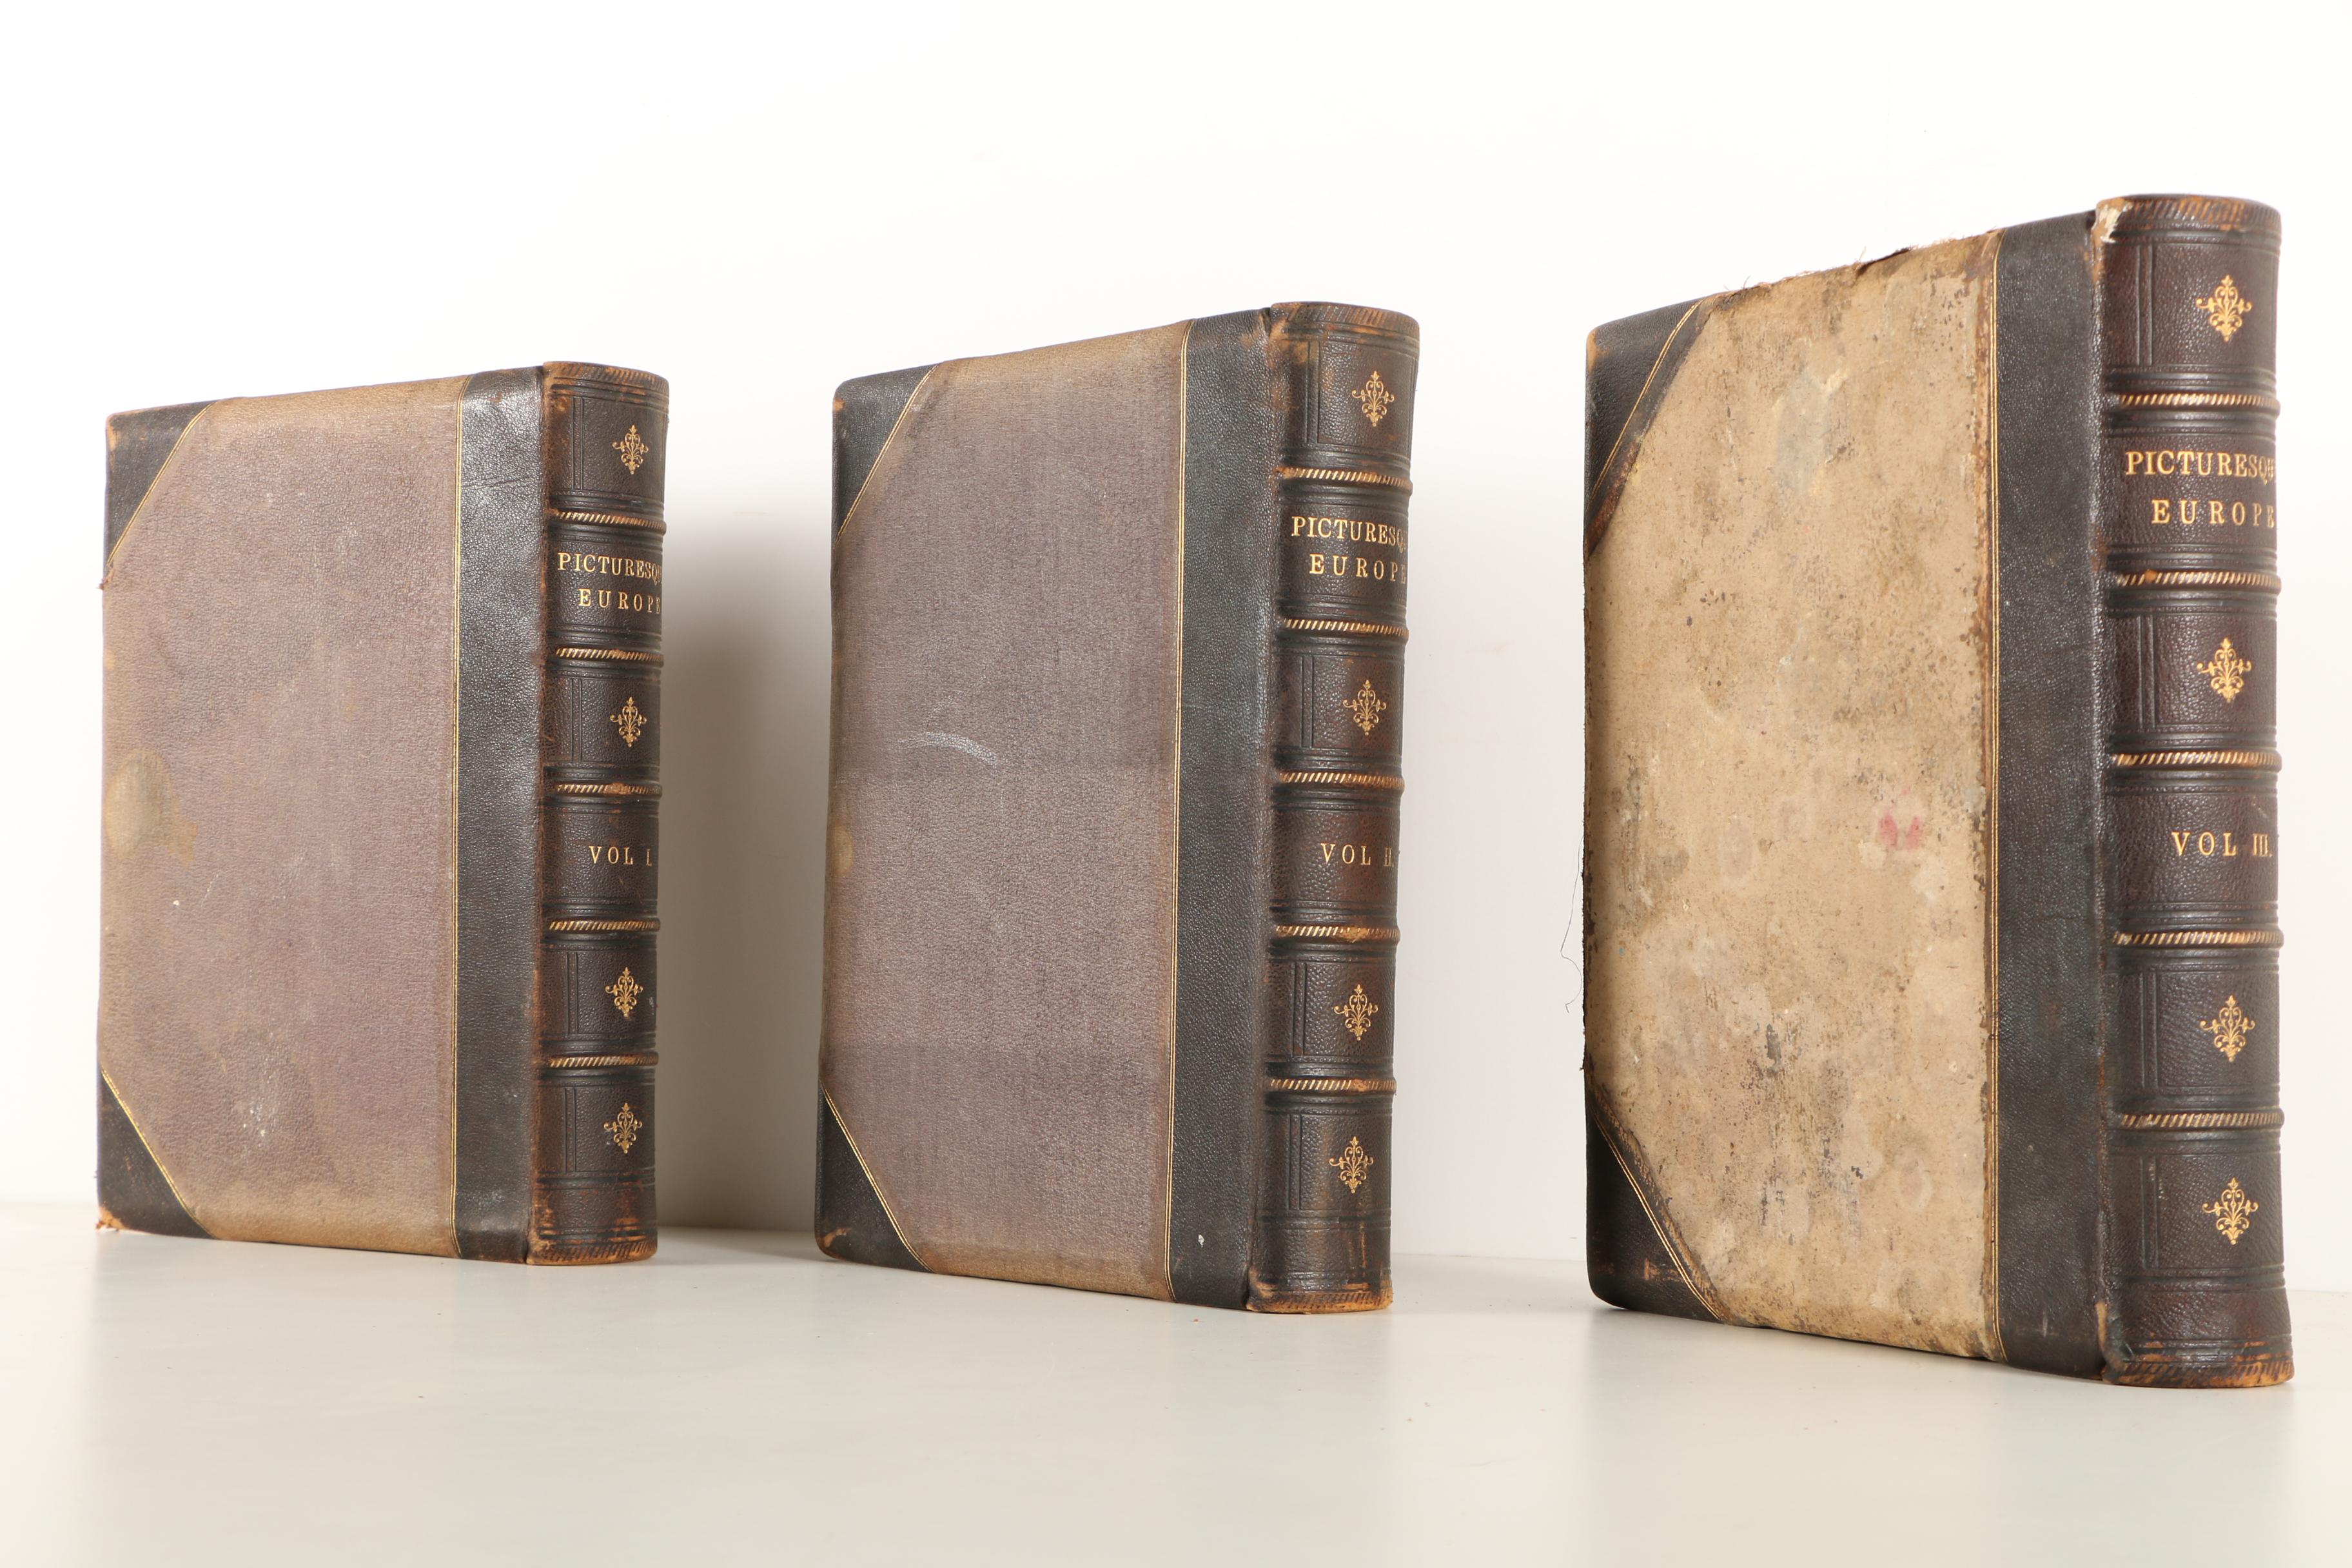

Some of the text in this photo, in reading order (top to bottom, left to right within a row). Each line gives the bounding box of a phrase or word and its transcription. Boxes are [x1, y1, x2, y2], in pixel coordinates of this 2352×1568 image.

[2125, 450, 2275, 485] PICTURESQ
[2151, 499, 2275, 529] EUROPE
[1291, 516, 1407, 553] PICTURESQ
[557, 552, 662, 585] PICTURESQ
[578, 588, 661, 614] EUROPE
[588, 845, 633, 865] VOL
[1320, 843, 1371, 866] VOL
[2171, 831, 2237, 857] VOL
